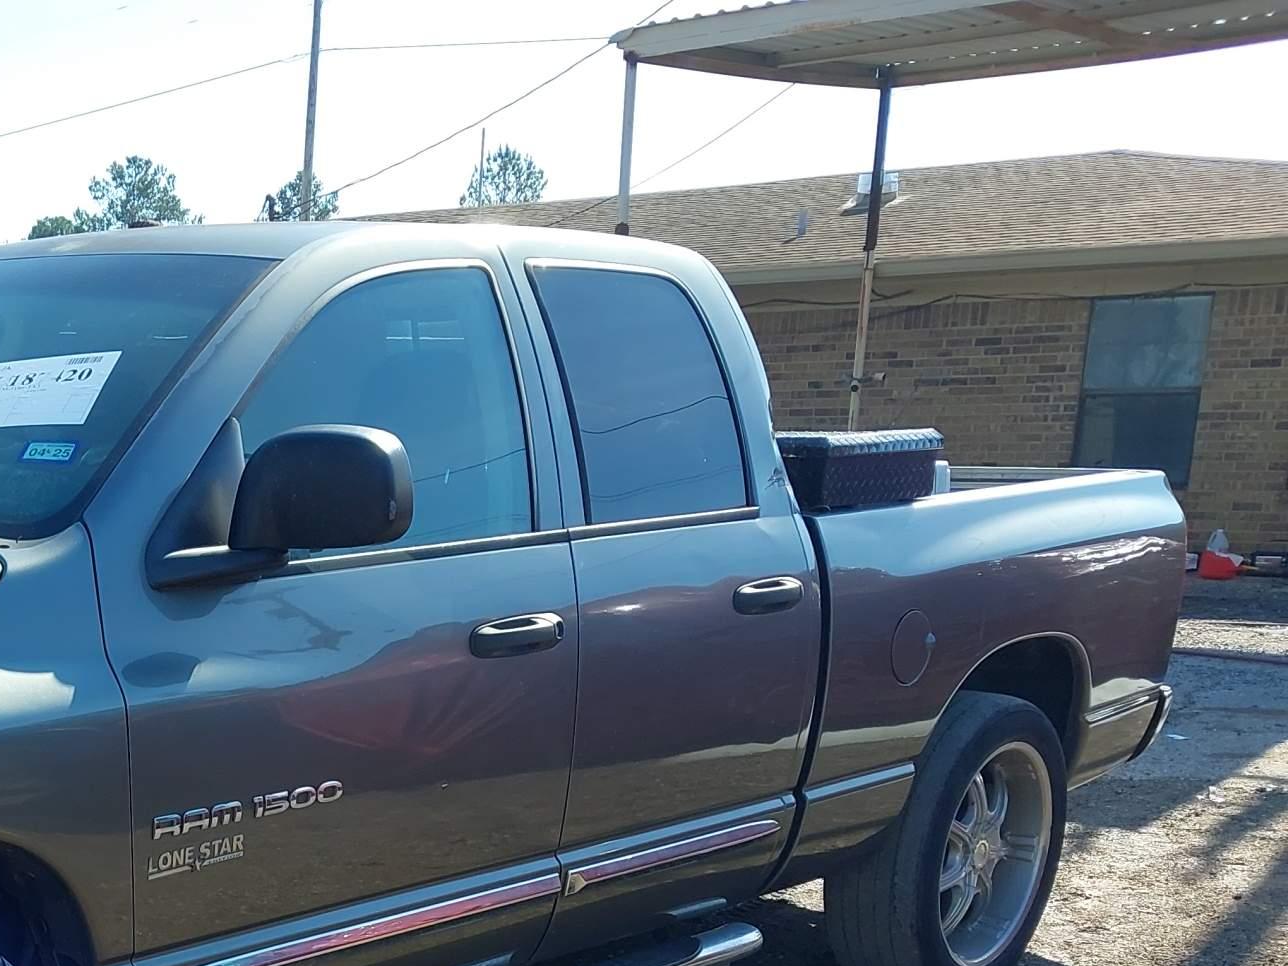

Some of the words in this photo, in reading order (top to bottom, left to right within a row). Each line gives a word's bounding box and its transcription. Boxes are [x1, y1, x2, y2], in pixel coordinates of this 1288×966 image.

[153, 800, 243, 840] RAM
[253, 780, 343, 818] 1500
[148, 846, 194, 873] LONE
[199, 834, 244, 859] STAR
